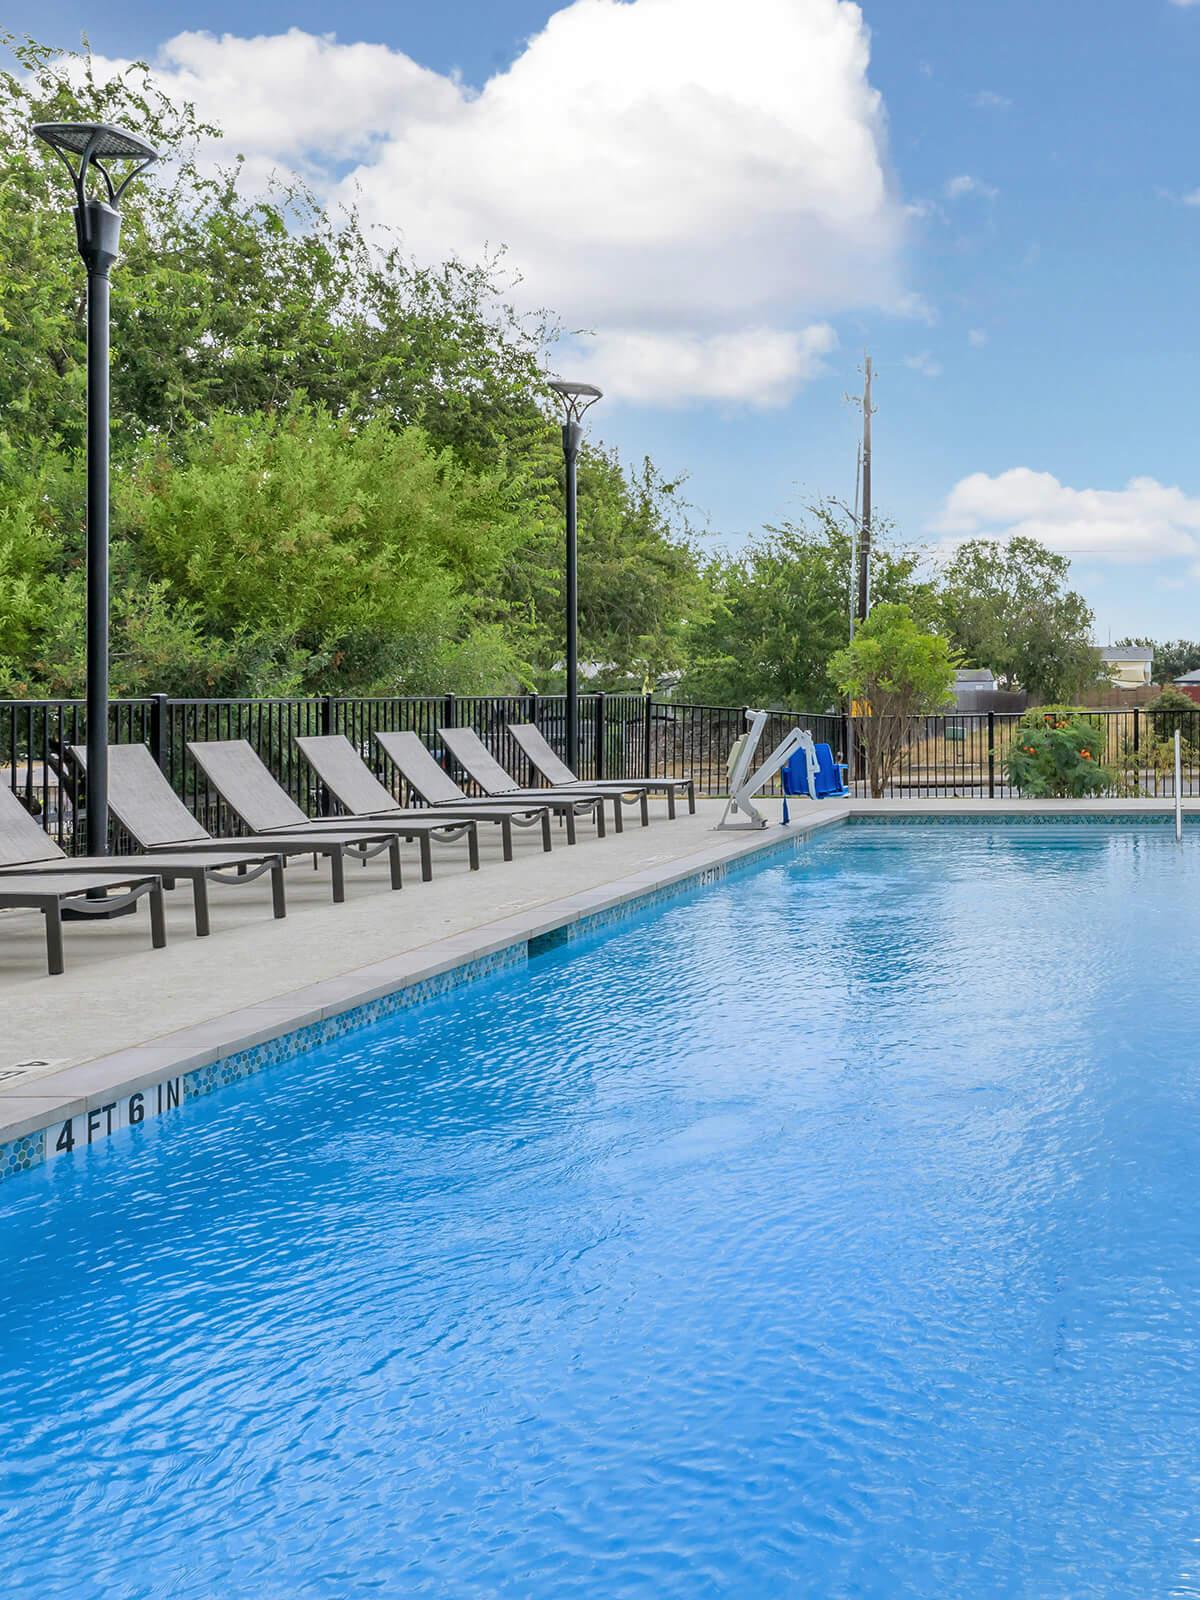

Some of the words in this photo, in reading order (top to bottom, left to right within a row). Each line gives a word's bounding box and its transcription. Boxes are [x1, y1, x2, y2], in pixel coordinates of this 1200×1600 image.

[56, 1118, 75, 1152] 4
[87, 1102, 117, 1144] FT
[128, 1092, 144, 1124] 6
[158, 1078, 180, 1114] IN
